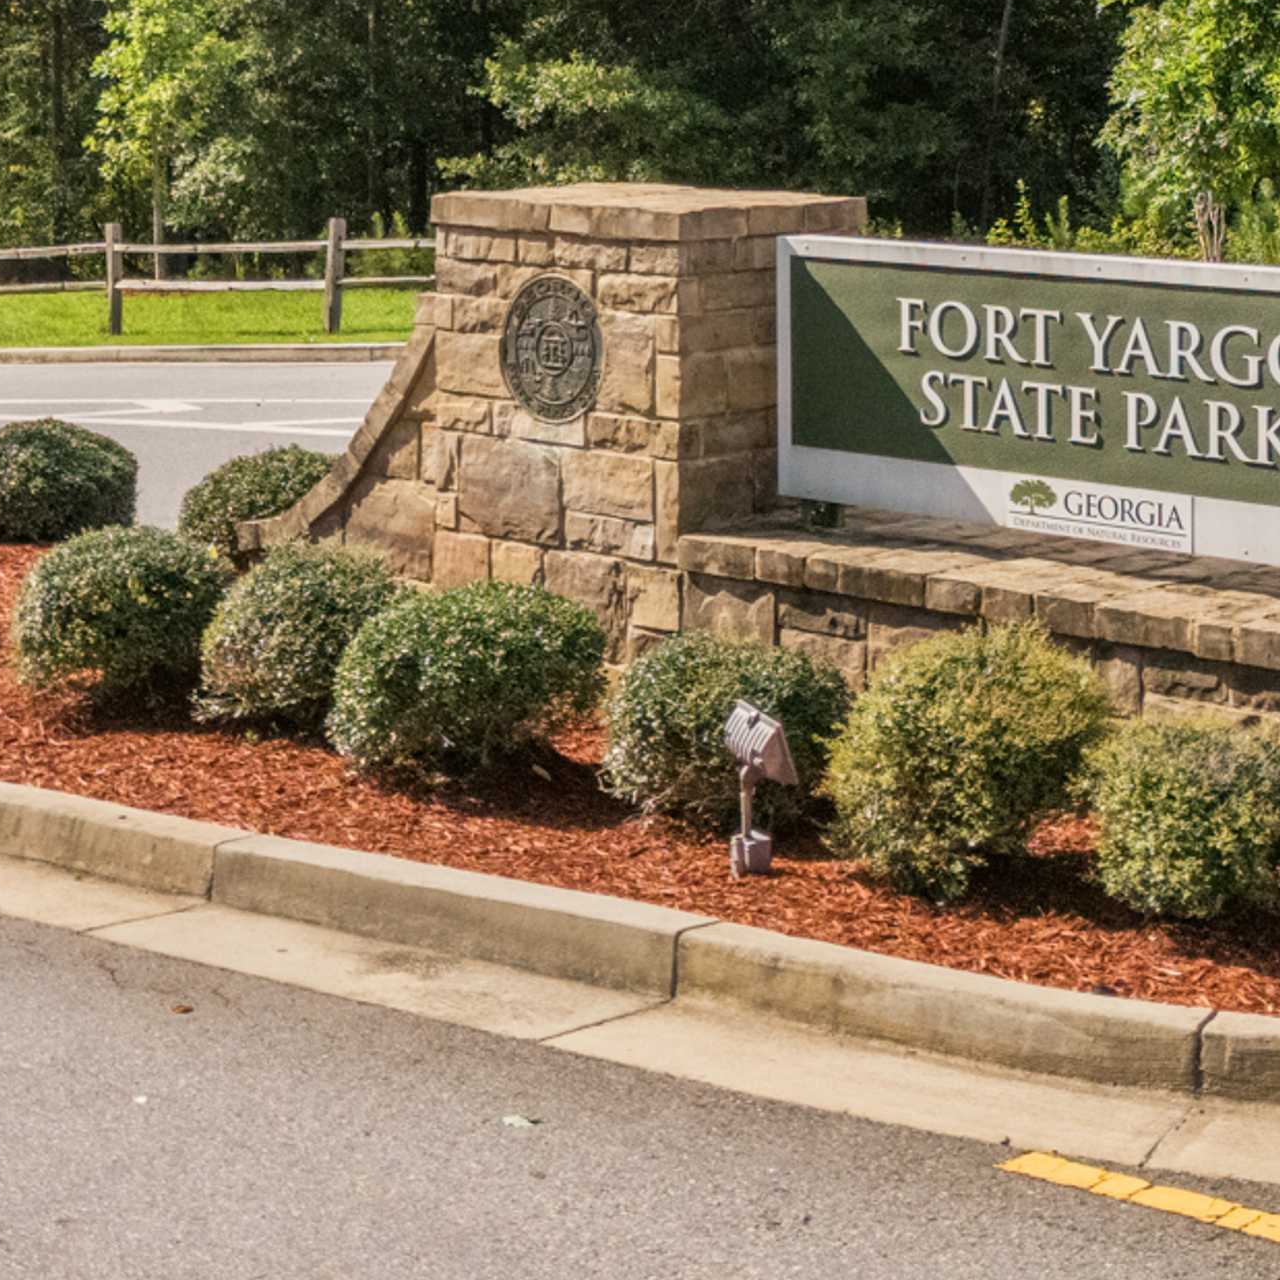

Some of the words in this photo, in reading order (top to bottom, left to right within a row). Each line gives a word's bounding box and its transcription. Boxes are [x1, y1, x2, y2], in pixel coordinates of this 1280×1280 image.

[896, 296, 1063, 368] FORT
[920, 370, 1101, 448] STATE
[1064, 490, 1184, 530] GEORGIA
